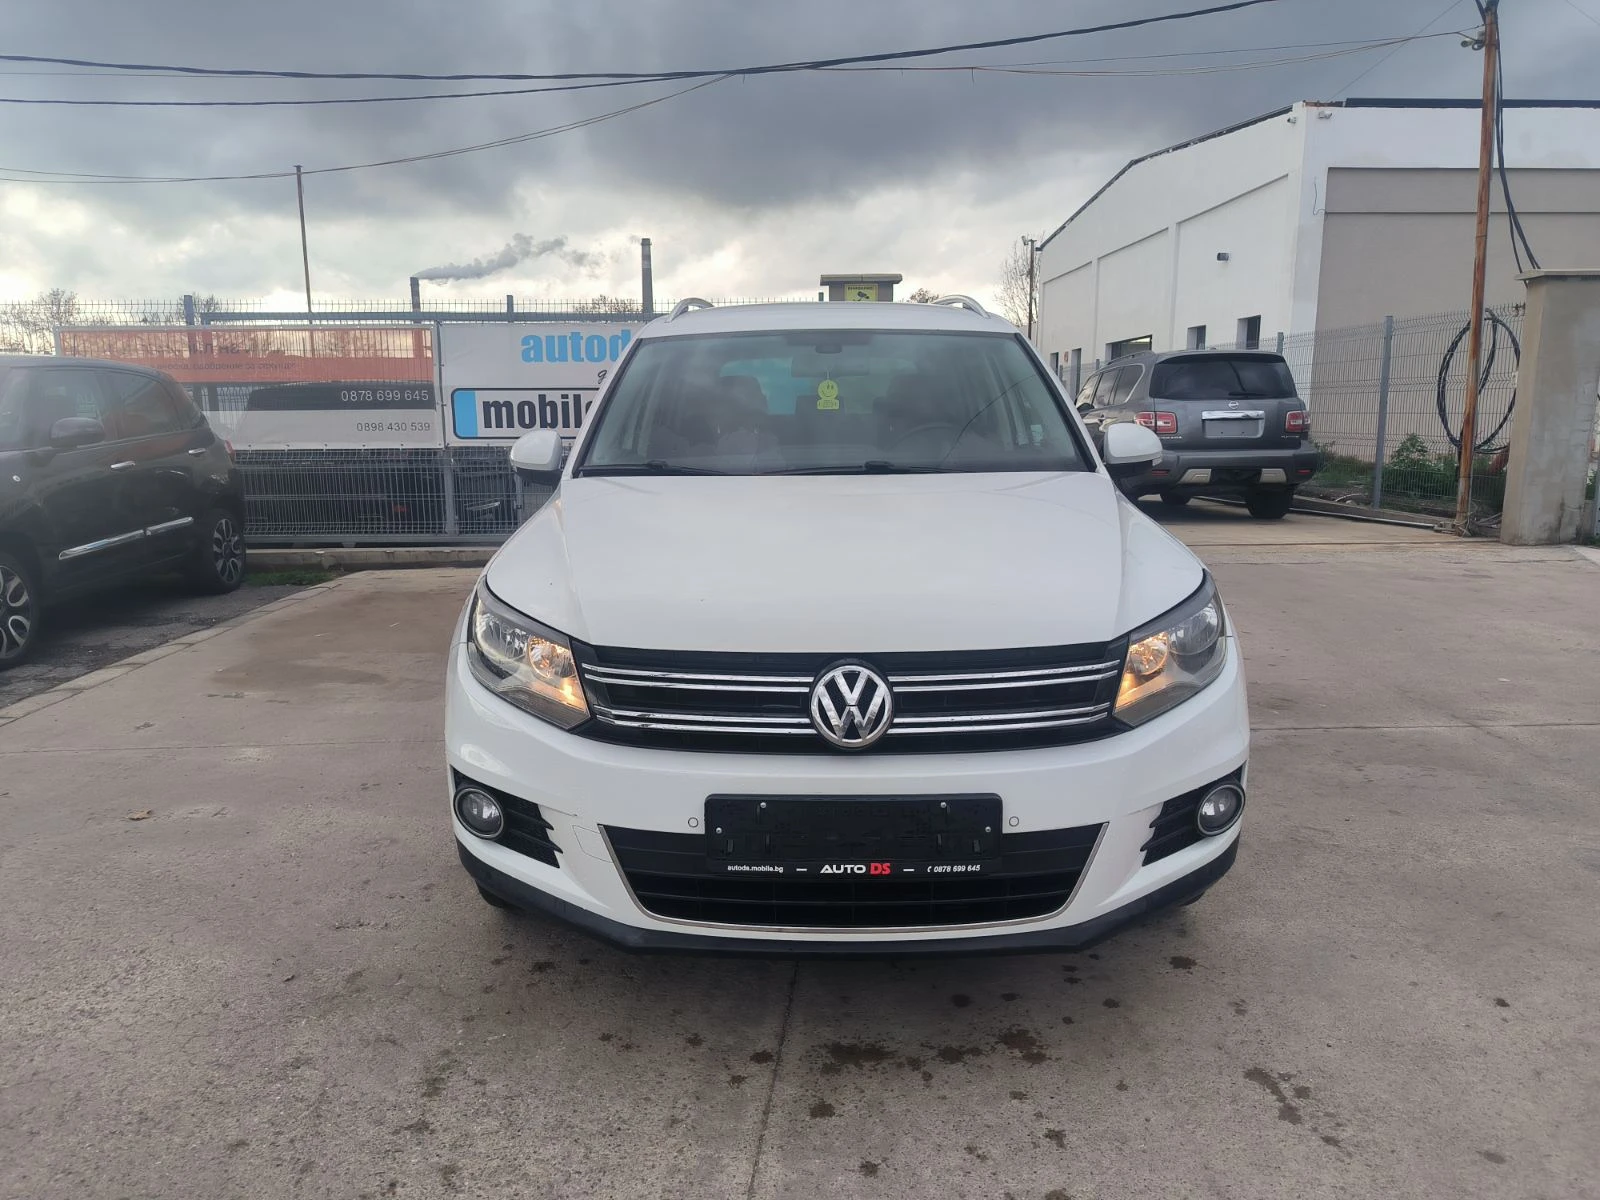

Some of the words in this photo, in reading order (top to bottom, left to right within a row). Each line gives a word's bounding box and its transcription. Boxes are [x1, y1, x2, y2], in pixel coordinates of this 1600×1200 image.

[341, 390, 373, 401] 0878
[376, 390, 400, 400] 699
[404, 390, 429, 400] 645
[356, 422, 384, 432] 0898
[387, 422, 407, 431] 430
[410, 422, 430, 431] 539
[820, 864, 866, 874] AUTO
[870, 862, 891, 875] DS
[933, 865, 951, 873] 0878
[967, 864, 981, 872] 645
